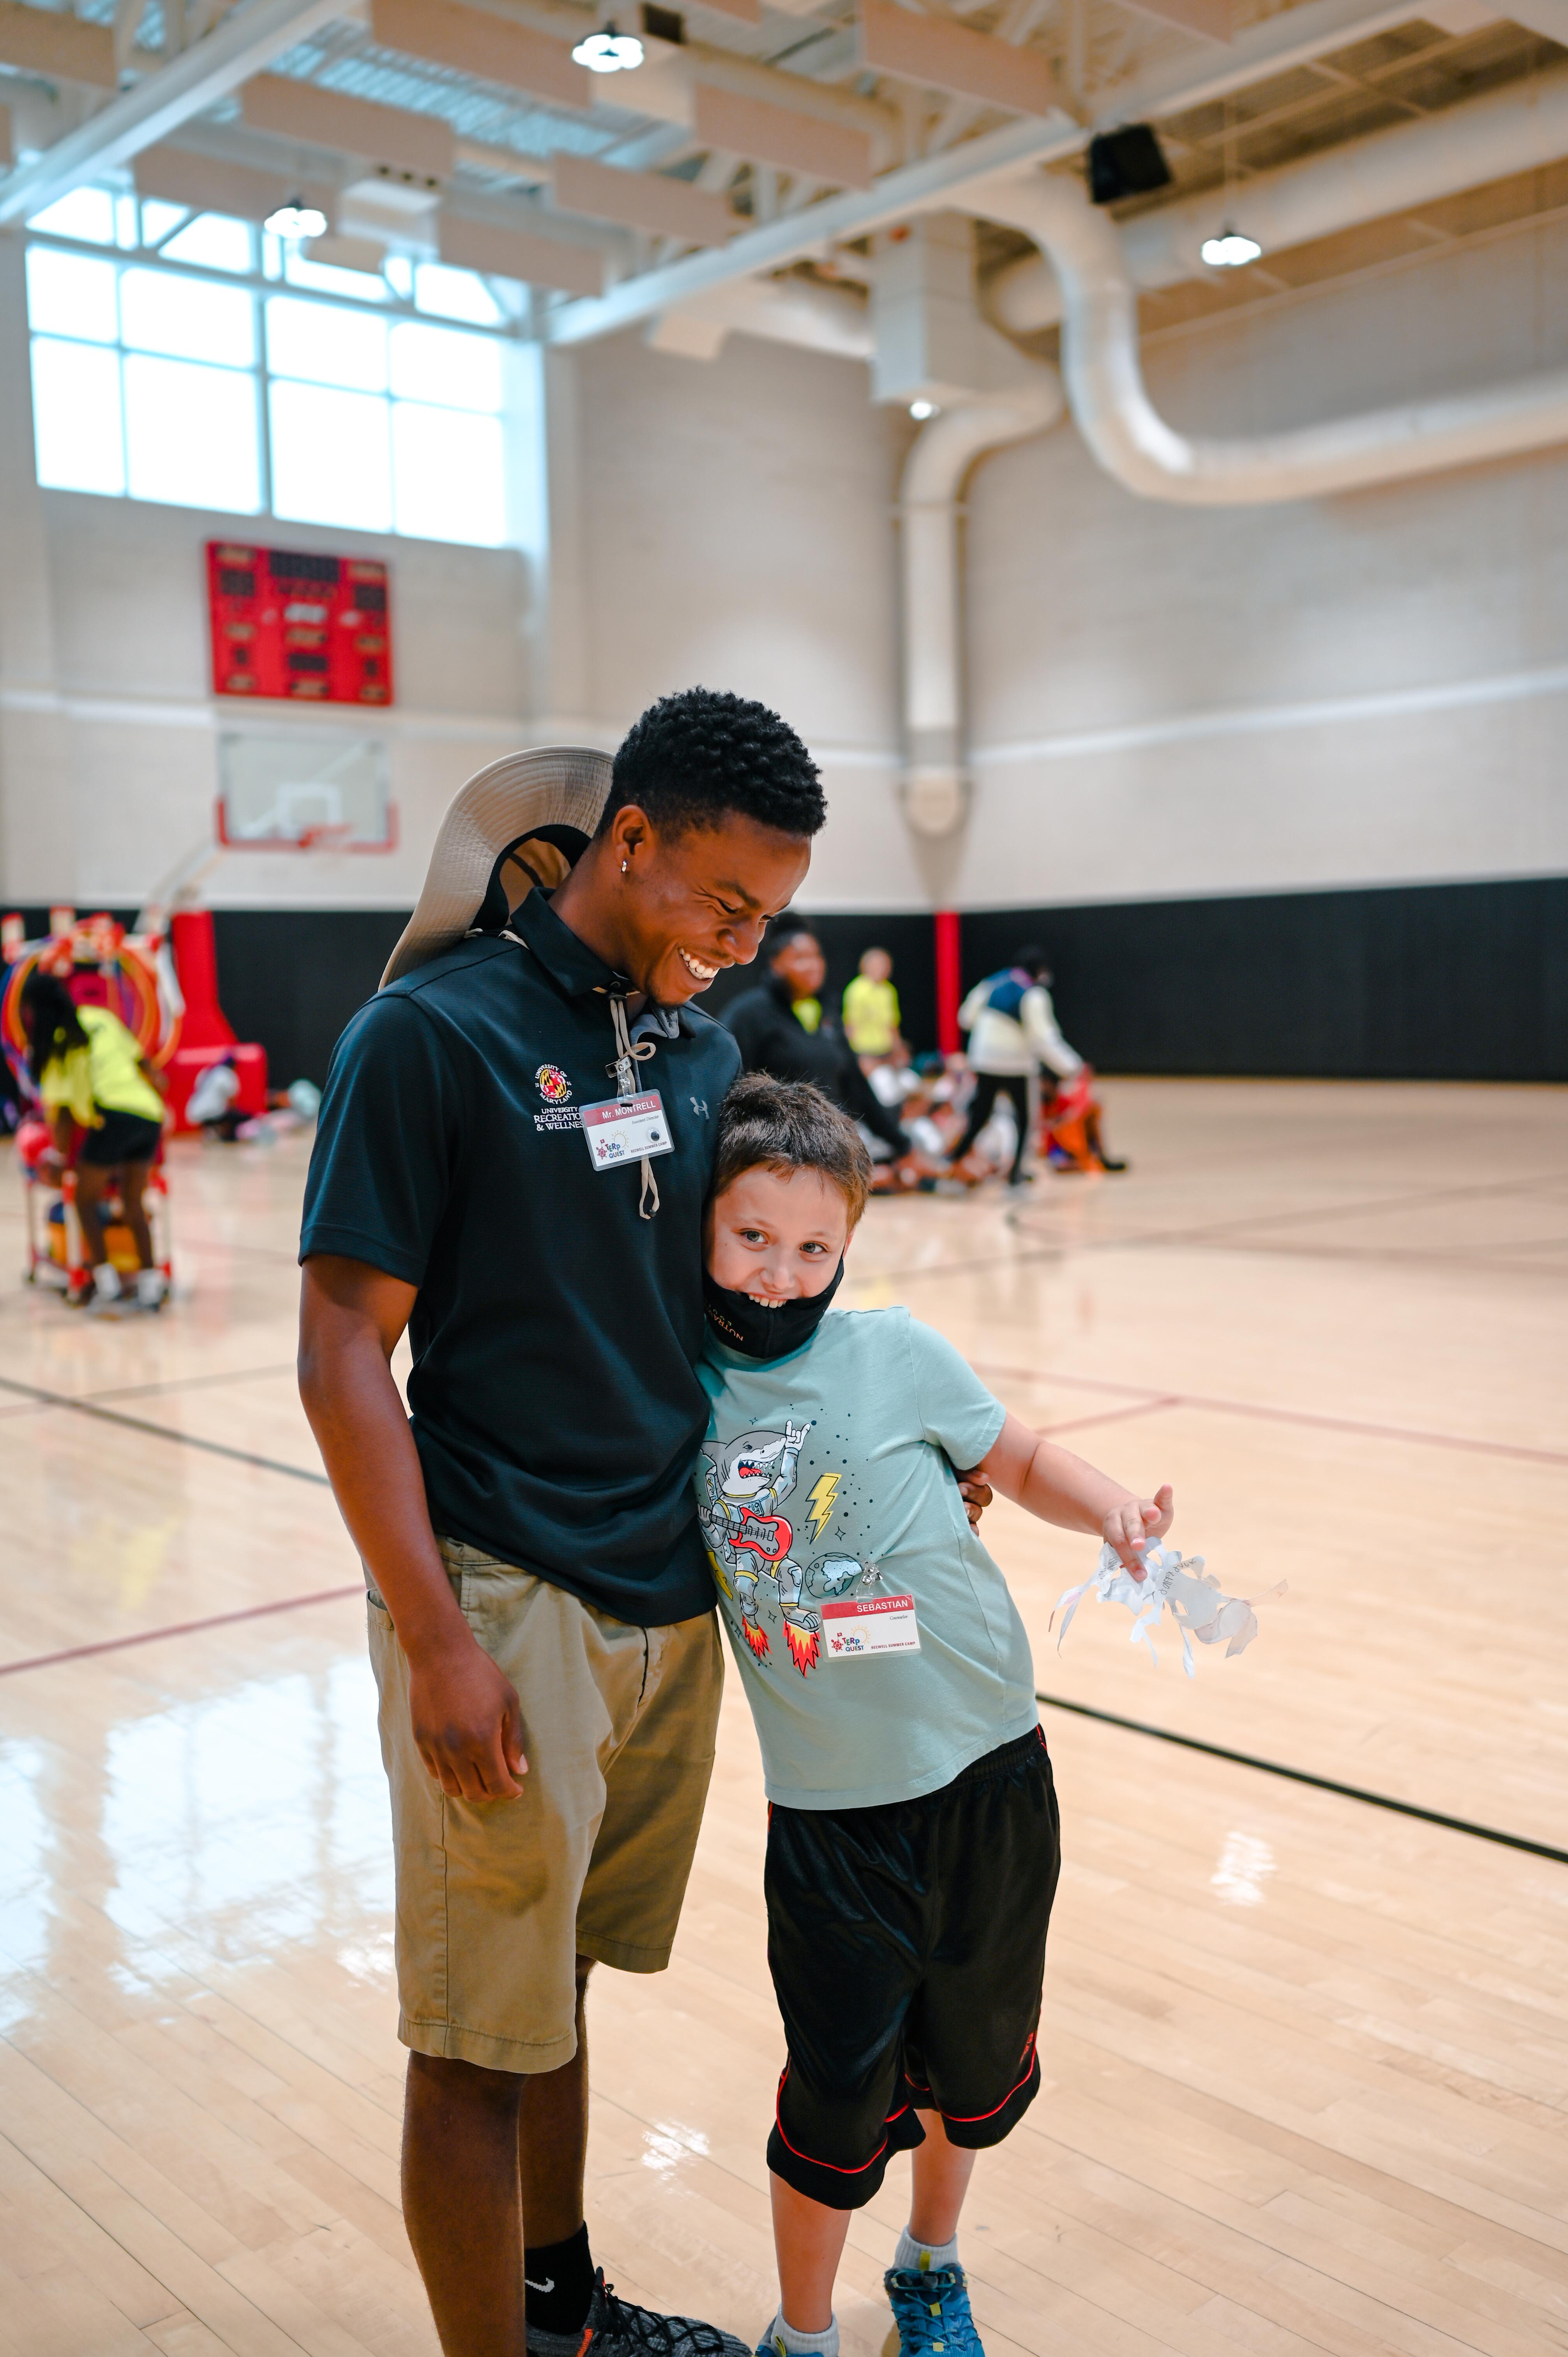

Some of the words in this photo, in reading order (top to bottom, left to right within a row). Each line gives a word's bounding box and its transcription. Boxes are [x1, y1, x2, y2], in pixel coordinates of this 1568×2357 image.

[535, 1064, 559, 1079] UNIVERSITY
[539, 1090, 572, 1104] MARYLAND
[602, 1111, 614, 1119] Mr.
[615, 1101, 656, 1116] MONTRELL
[533, 1113, 581, 1123] RECREATIO
[605, 1143, 621, 1152] TERP
[609, 1150, 625, 1158] QUEST
[857, 1600, 908, 1613] SEBASTIAN
[842, 1637, 860, 1646] TERP
